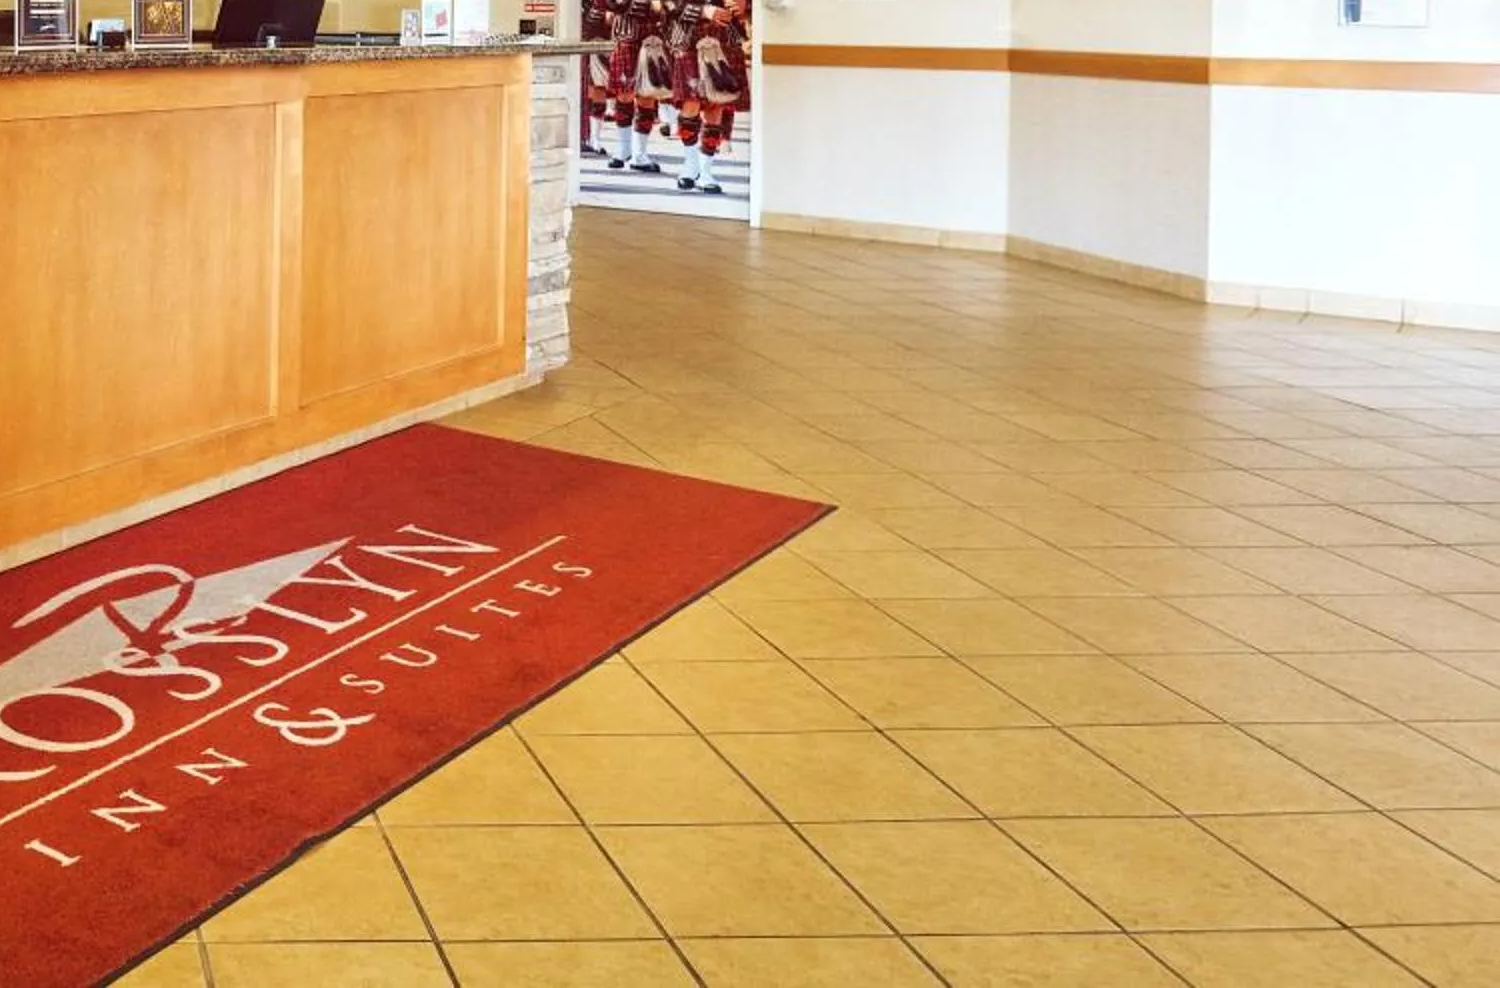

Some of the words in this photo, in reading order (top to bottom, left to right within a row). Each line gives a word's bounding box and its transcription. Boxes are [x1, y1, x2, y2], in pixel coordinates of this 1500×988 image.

[23, 747, 249, 868] INN
[252, 701, 376, 747] &
[339, 559, 594, 695] SUITES
